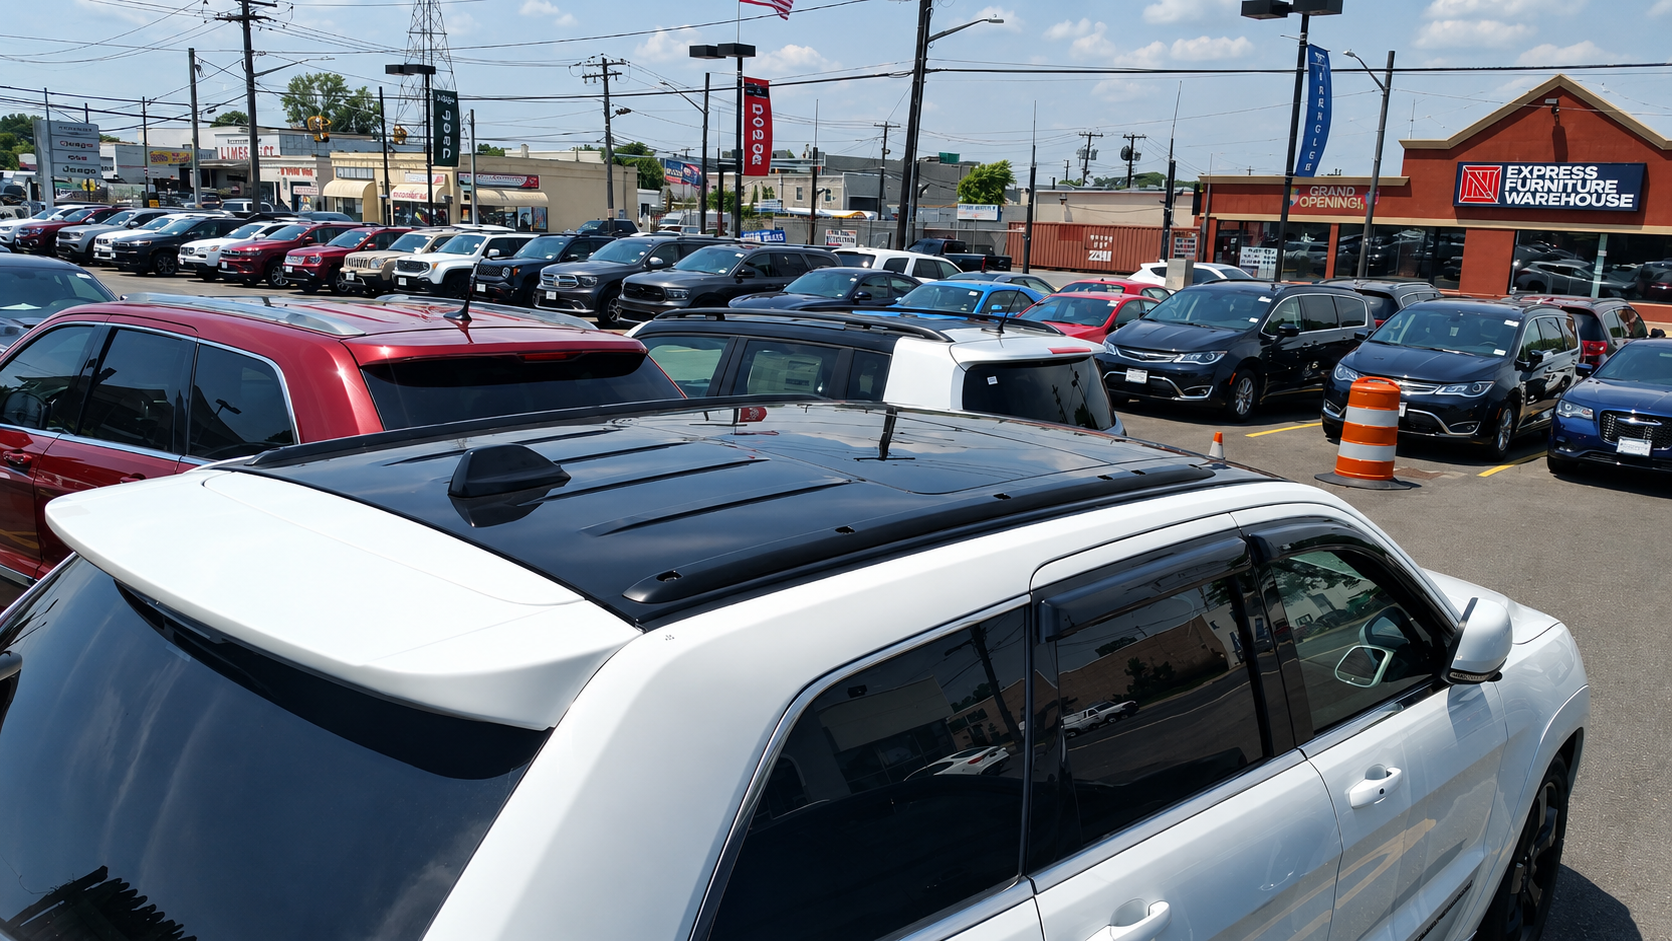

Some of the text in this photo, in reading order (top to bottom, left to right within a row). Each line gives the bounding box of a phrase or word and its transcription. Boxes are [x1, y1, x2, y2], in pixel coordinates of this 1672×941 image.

[1506, 165, 1598, 179] EXPRESS
[1310, 186, 1356, 197] GRAND
[1504, 179, 1618, 193] FURNITURE
[1299, 196, 1362, 209] OPENING!
[1504, 192, 1635, 207] WAREHOUSE
